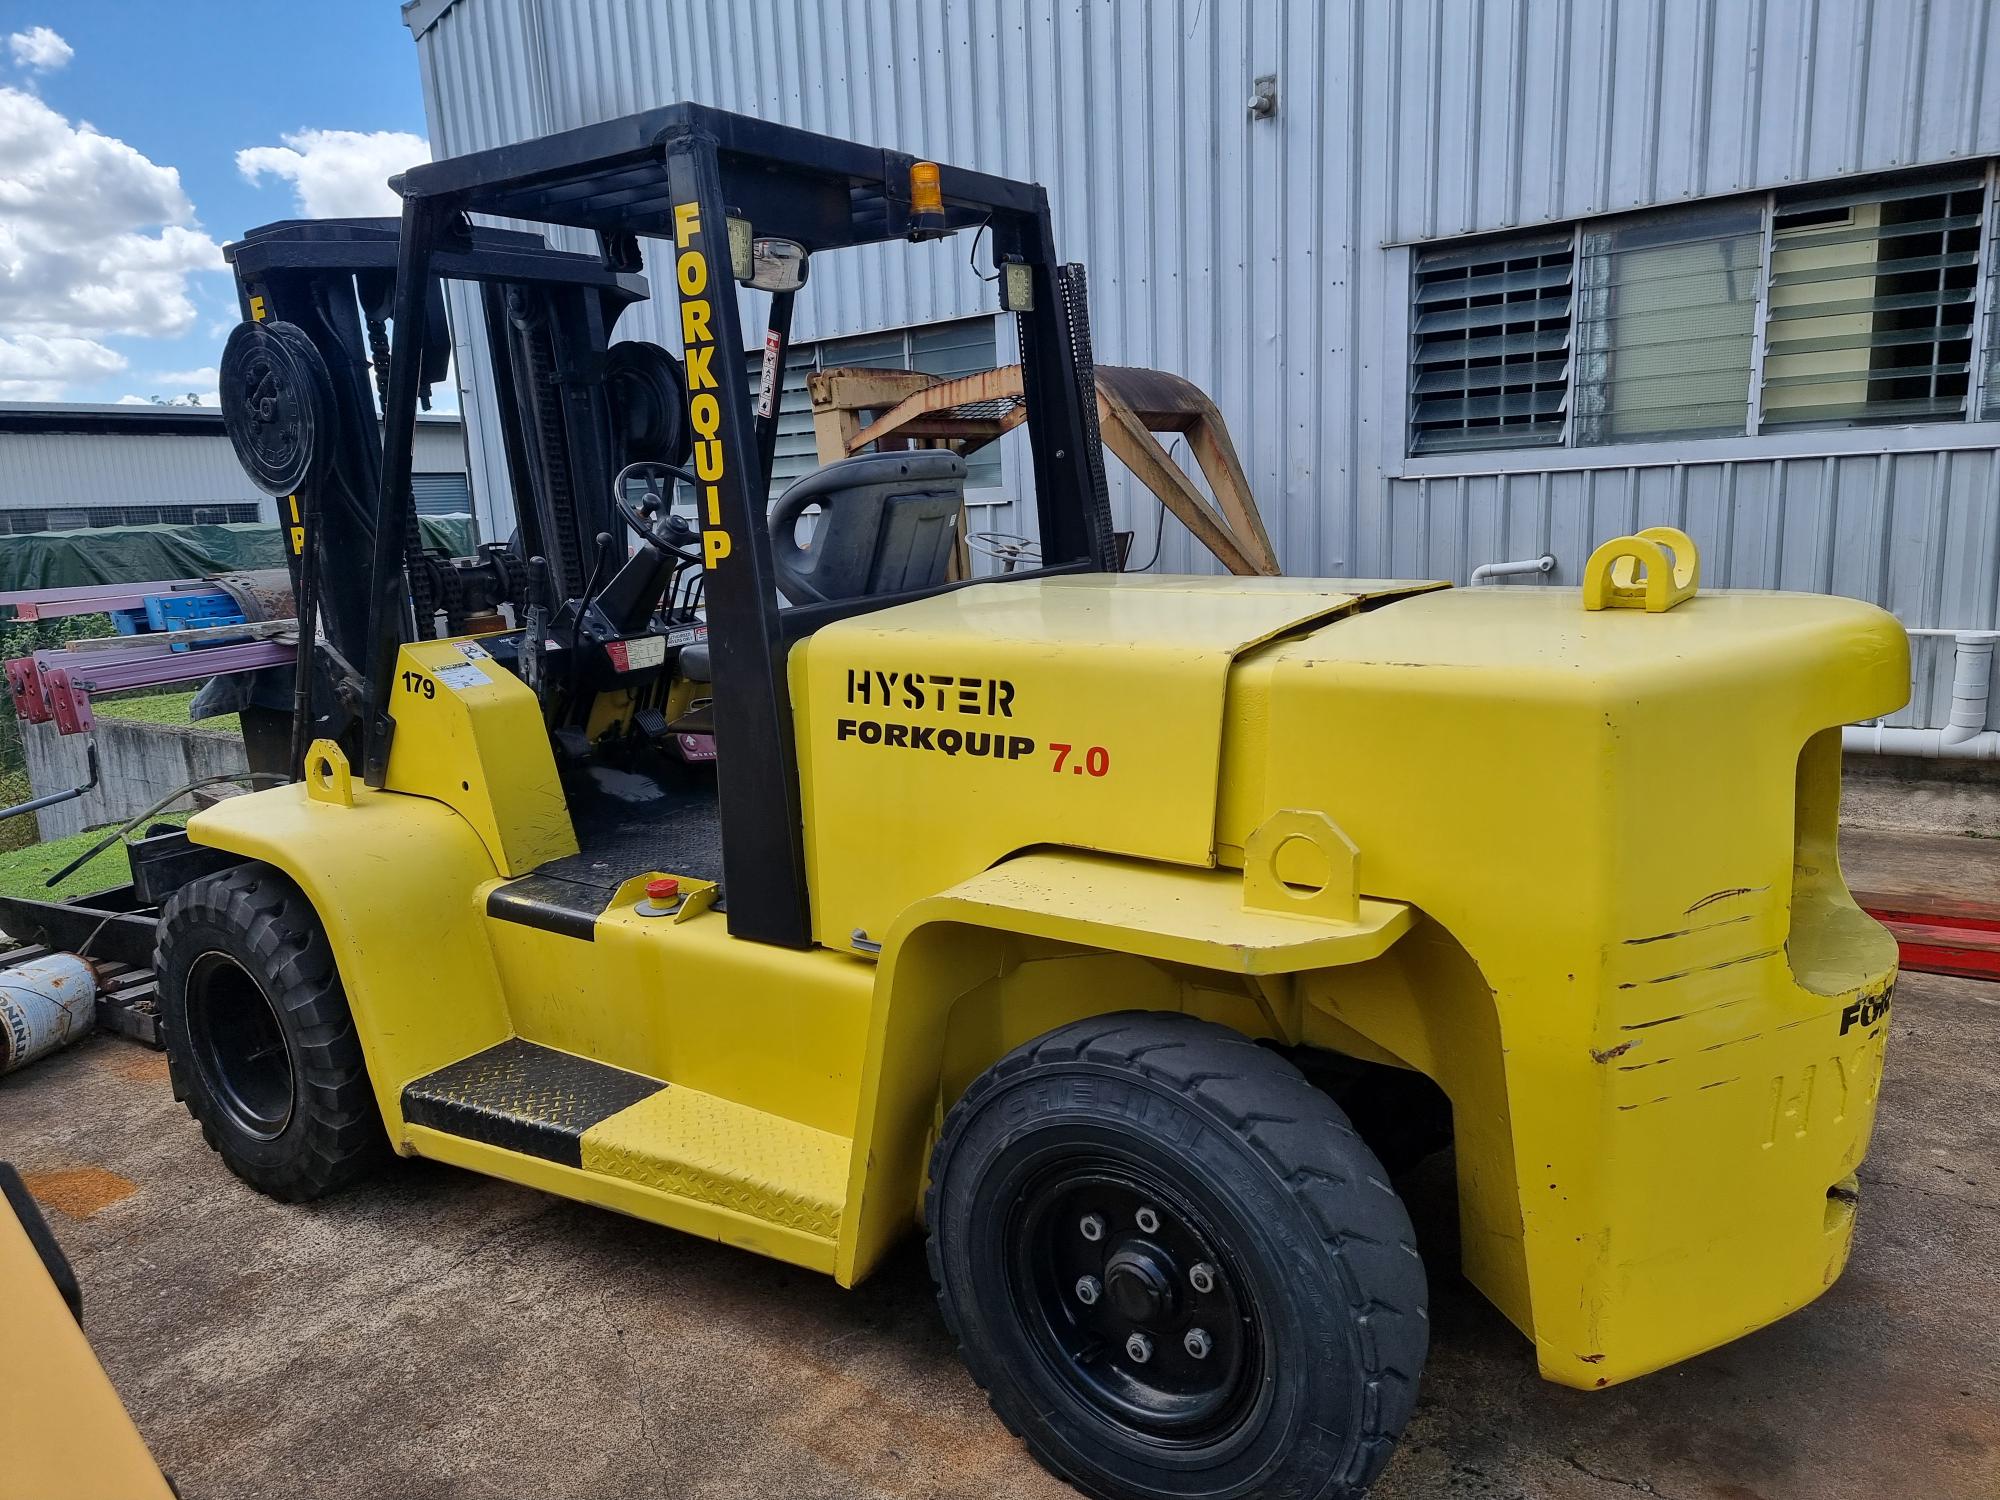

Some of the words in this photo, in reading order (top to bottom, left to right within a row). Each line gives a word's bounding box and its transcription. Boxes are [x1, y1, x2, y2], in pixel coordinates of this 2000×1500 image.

[674, 201, 732, 570] FORKQUIP
[402, 671, 435, 700] 179
[847, 669, 1015, 718] HYSTER
[837, 718, 1035, 760] FORKQUIP
[1049, 743, 1110, 777] 7.0
[1762, 1044, 1882, 1150] HY
